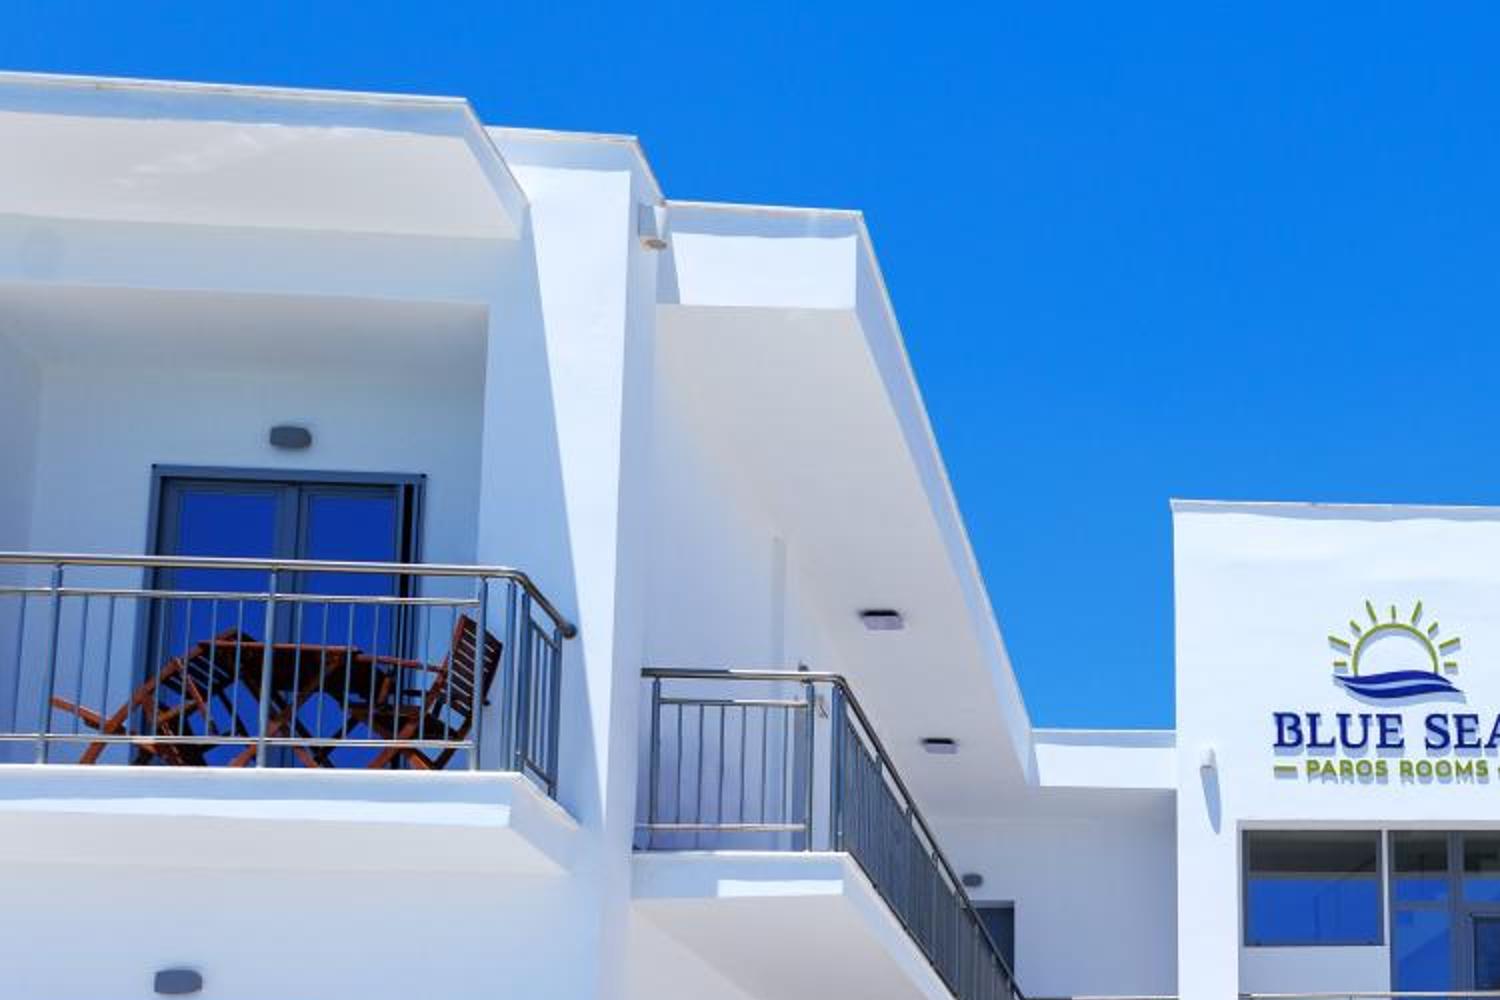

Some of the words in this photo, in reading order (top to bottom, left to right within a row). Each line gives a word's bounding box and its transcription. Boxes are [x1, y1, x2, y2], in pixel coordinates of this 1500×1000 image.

[1273, 711, 1405, 749] BLUE
[1306, 759, 1388, 777] PAROS
[1400, 760, 1489, 777] ROOMS
